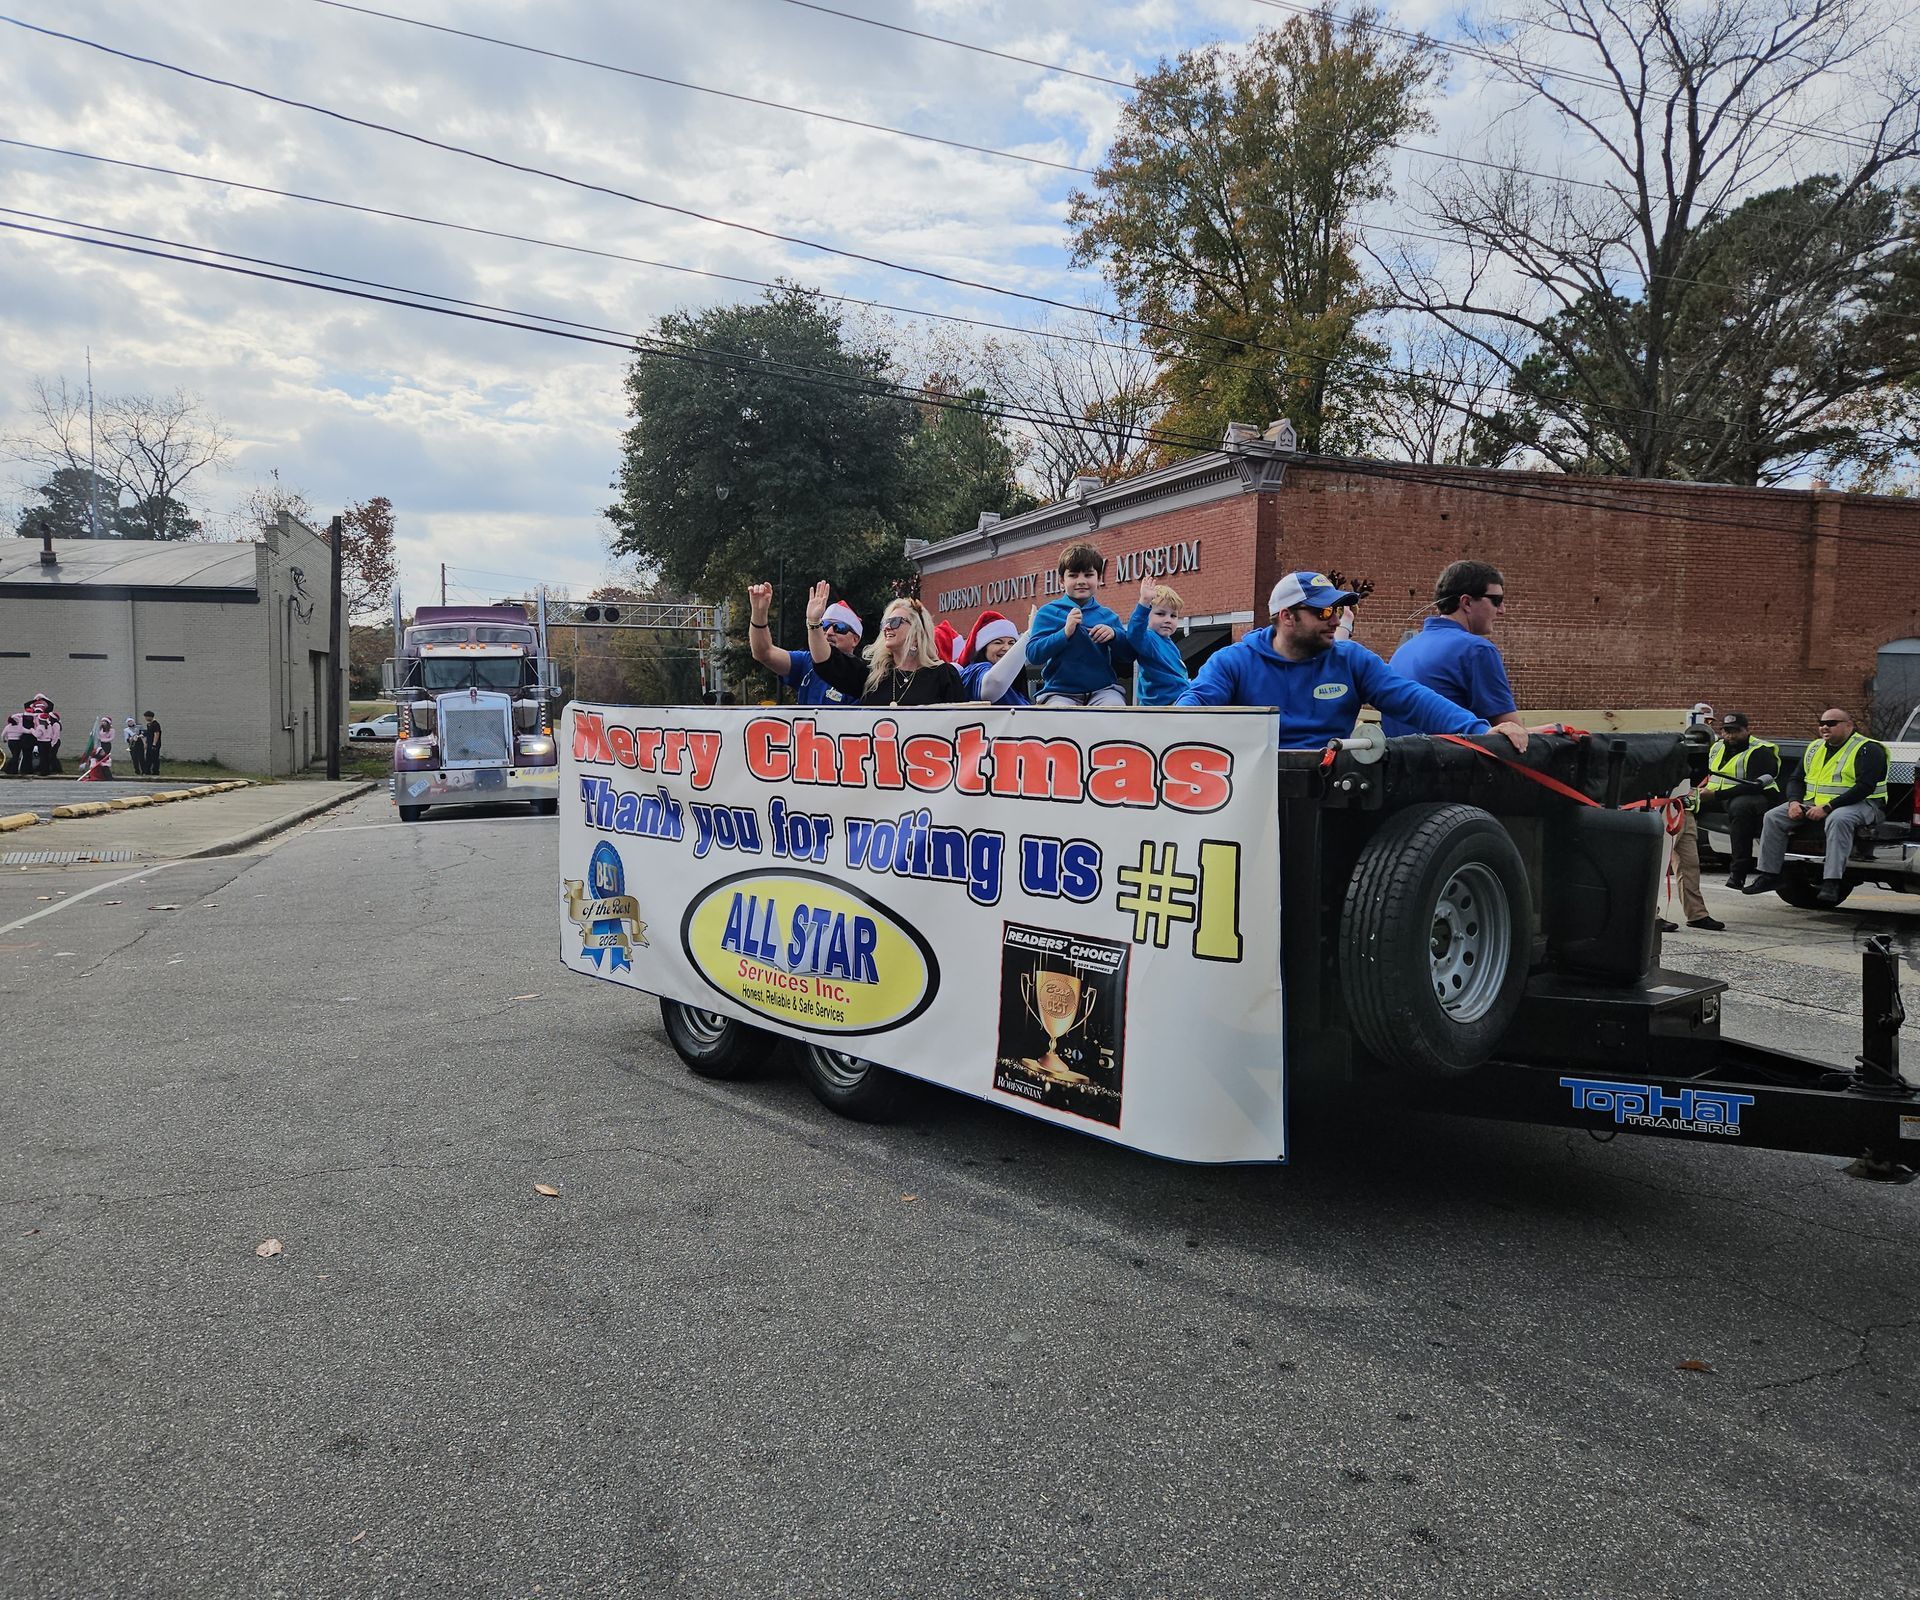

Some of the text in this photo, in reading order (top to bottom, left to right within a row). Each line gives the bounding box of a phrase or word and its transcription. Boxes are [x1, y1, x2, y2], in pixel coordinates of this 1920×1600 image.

[938, 585, 982, 612] ROBESON
[986, 573, 1038, 605] COUNTY
[1115, 540, 1201, 583] MUSEUM
[572, 710, 1234, 814] Merry Christmas
[580, 774, 1243, 963] Thank you for voting us #1
[596, 861, 619, 893] BEST
[582, 898, 631, 920] of the Best
[598, 935, 618, 947] 2025
[720, 892, 880, 985] ALL STAR
[1070, 945, 1121, 963] CHOICE
[737, 959, 851, 1004] Services Inc.
[742, 983, 845, 1022] Honest, Reliable & Safe Services
[1625, 1114, 1741, 1136] TRAILERS
